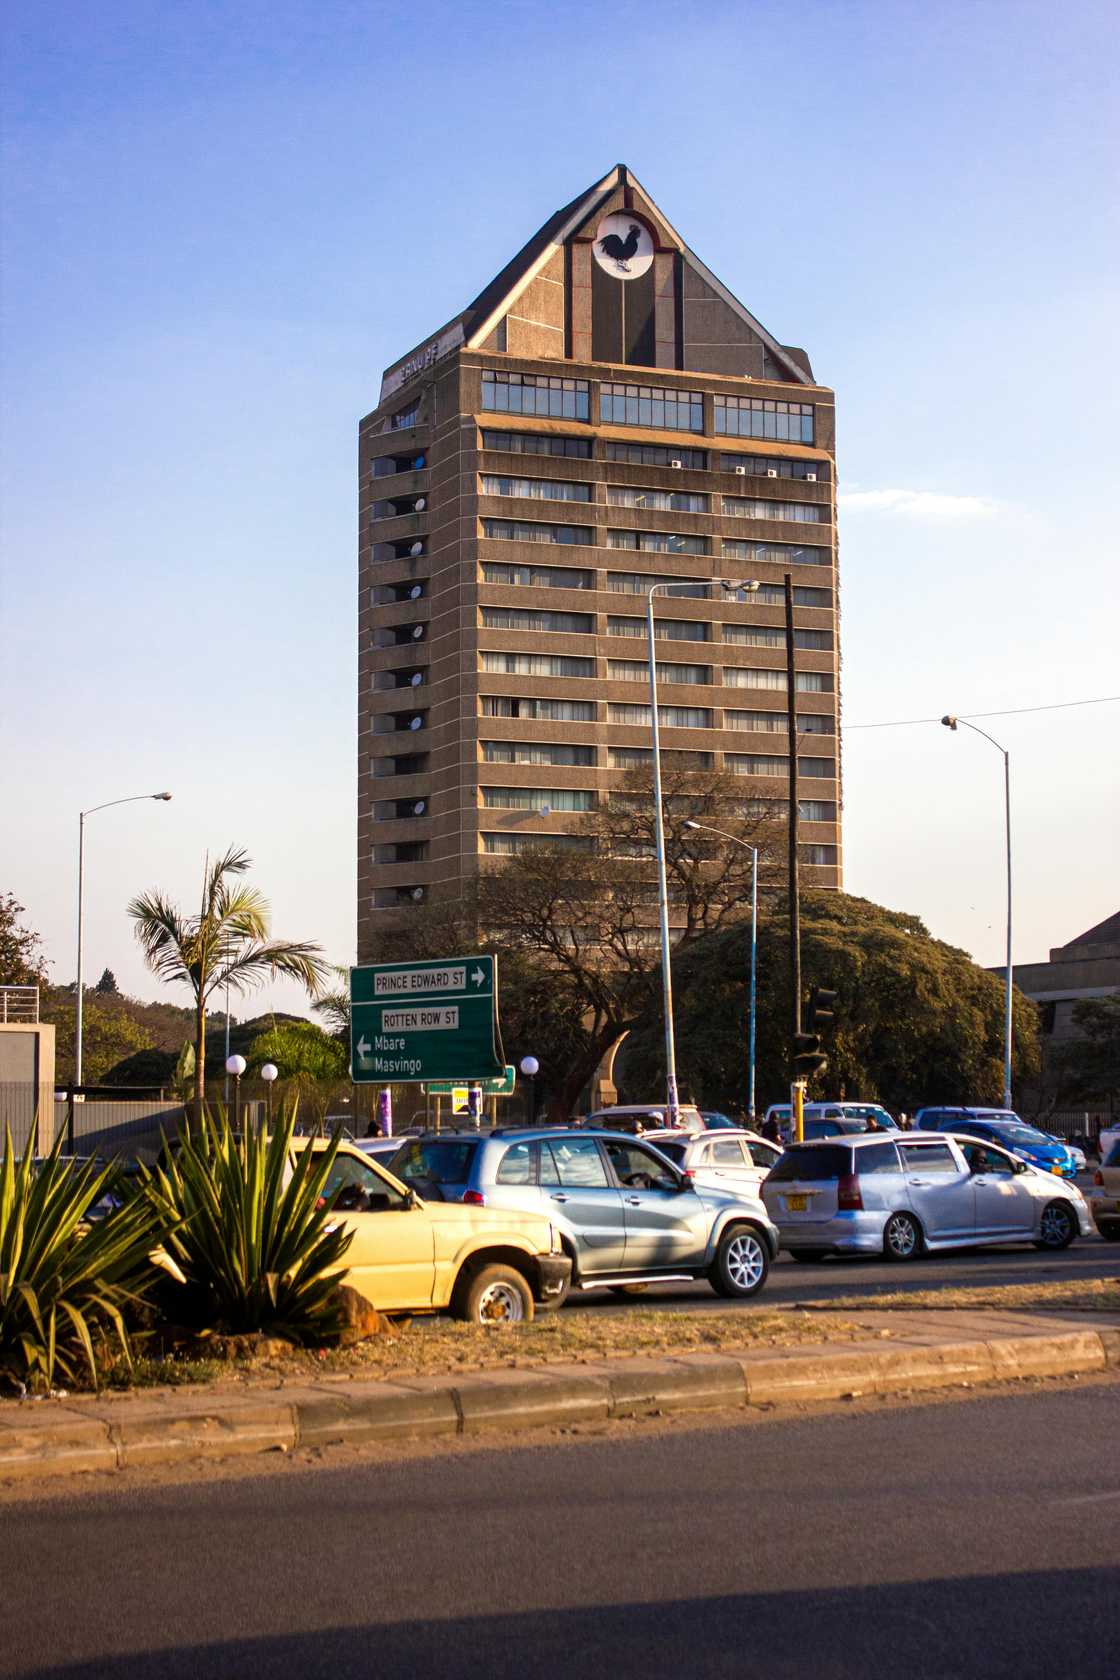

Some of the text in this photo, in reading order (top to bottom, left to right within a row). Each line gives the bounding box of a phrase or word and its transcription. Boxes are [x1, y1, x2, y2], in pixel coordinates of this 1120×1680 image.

[376, 971, 464, 991] PRINCE EDWARD ST
[384, 1011, 456, 1027] ROTTEN ROW ST
[375, 1036, 405, 1050] Mbare
[375, 1057, 422, 1075] Masvingo
